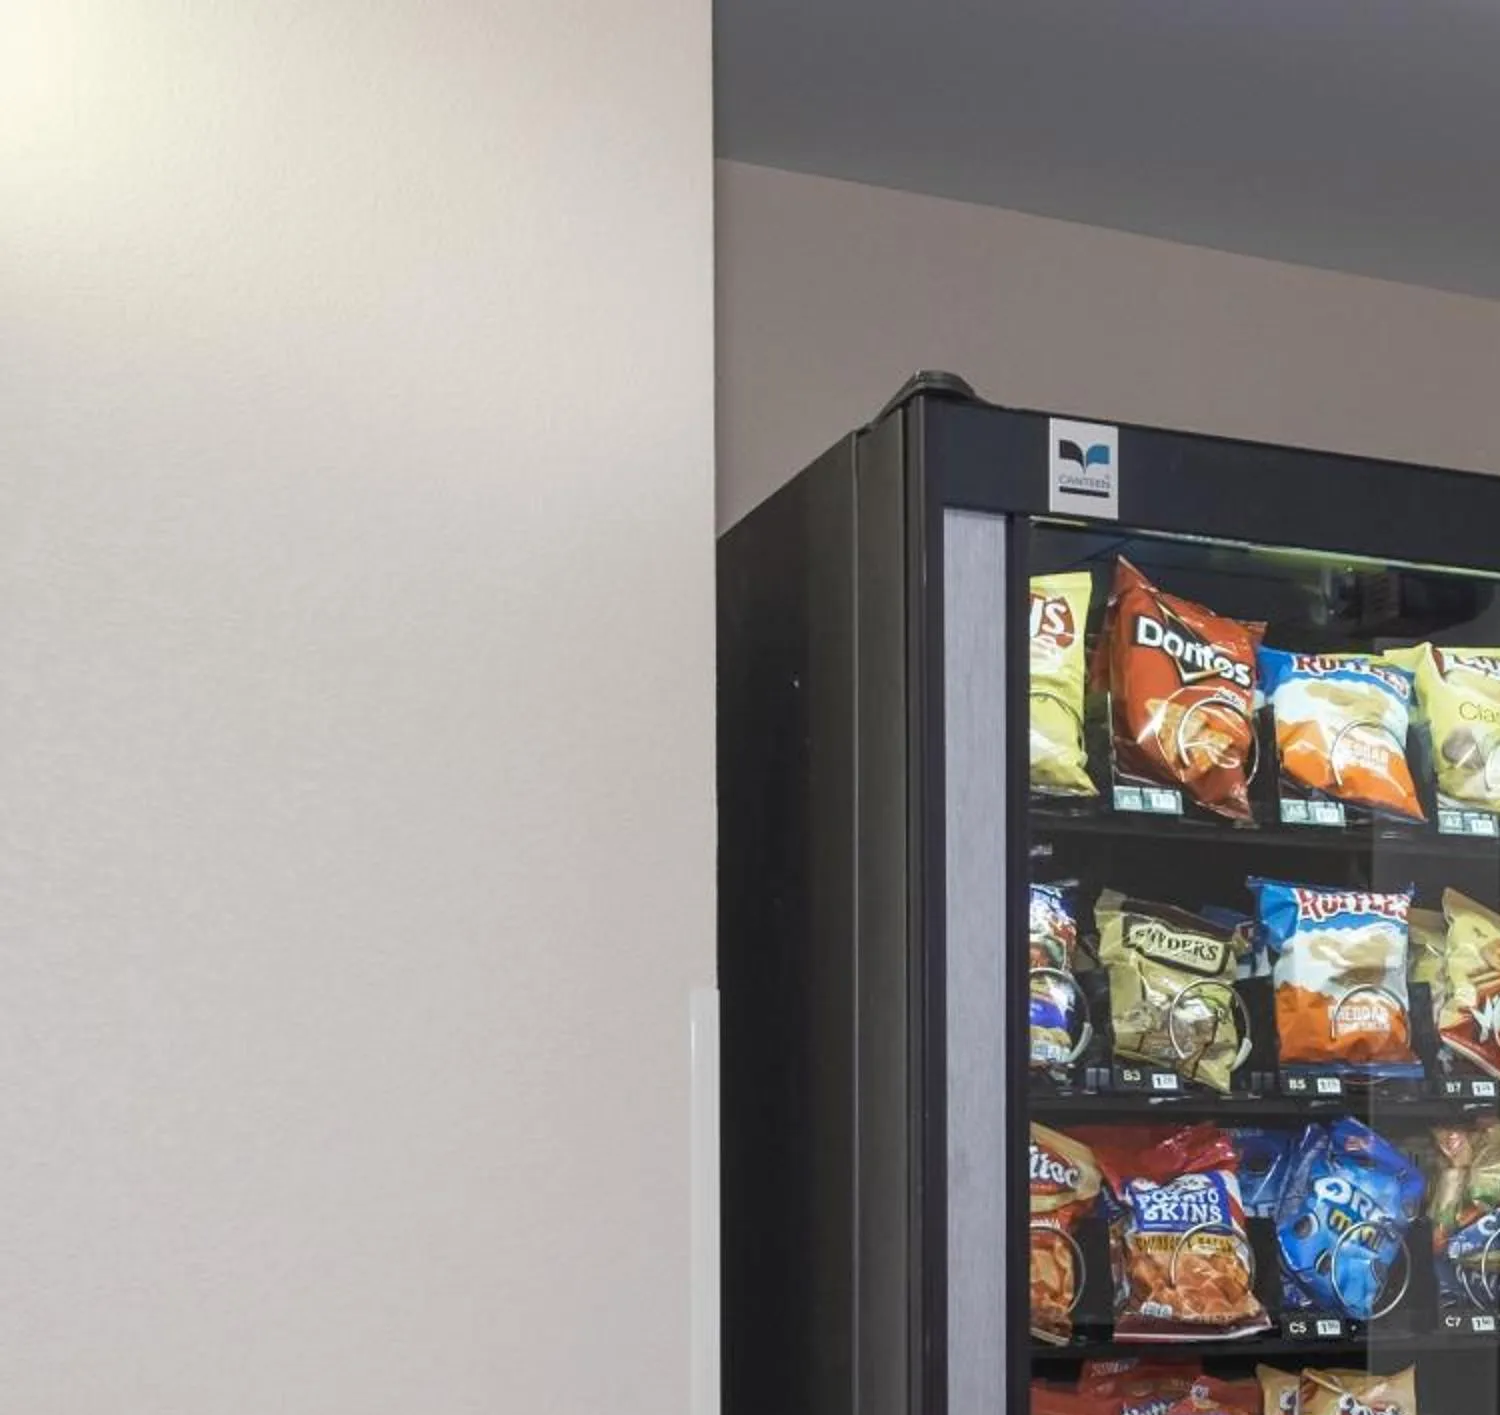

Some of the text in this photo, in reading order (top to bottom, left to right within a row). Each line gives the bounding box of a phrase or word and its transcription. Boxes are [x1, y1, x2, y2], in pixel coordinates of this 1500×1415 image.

[1136, 617, 1251, 687] Doritos
[1144, 1203, 1222, 1223] SKINS
[1289, 1322, 1307, 1334] C5
[1445, 1315, 1461, 1327] C7
